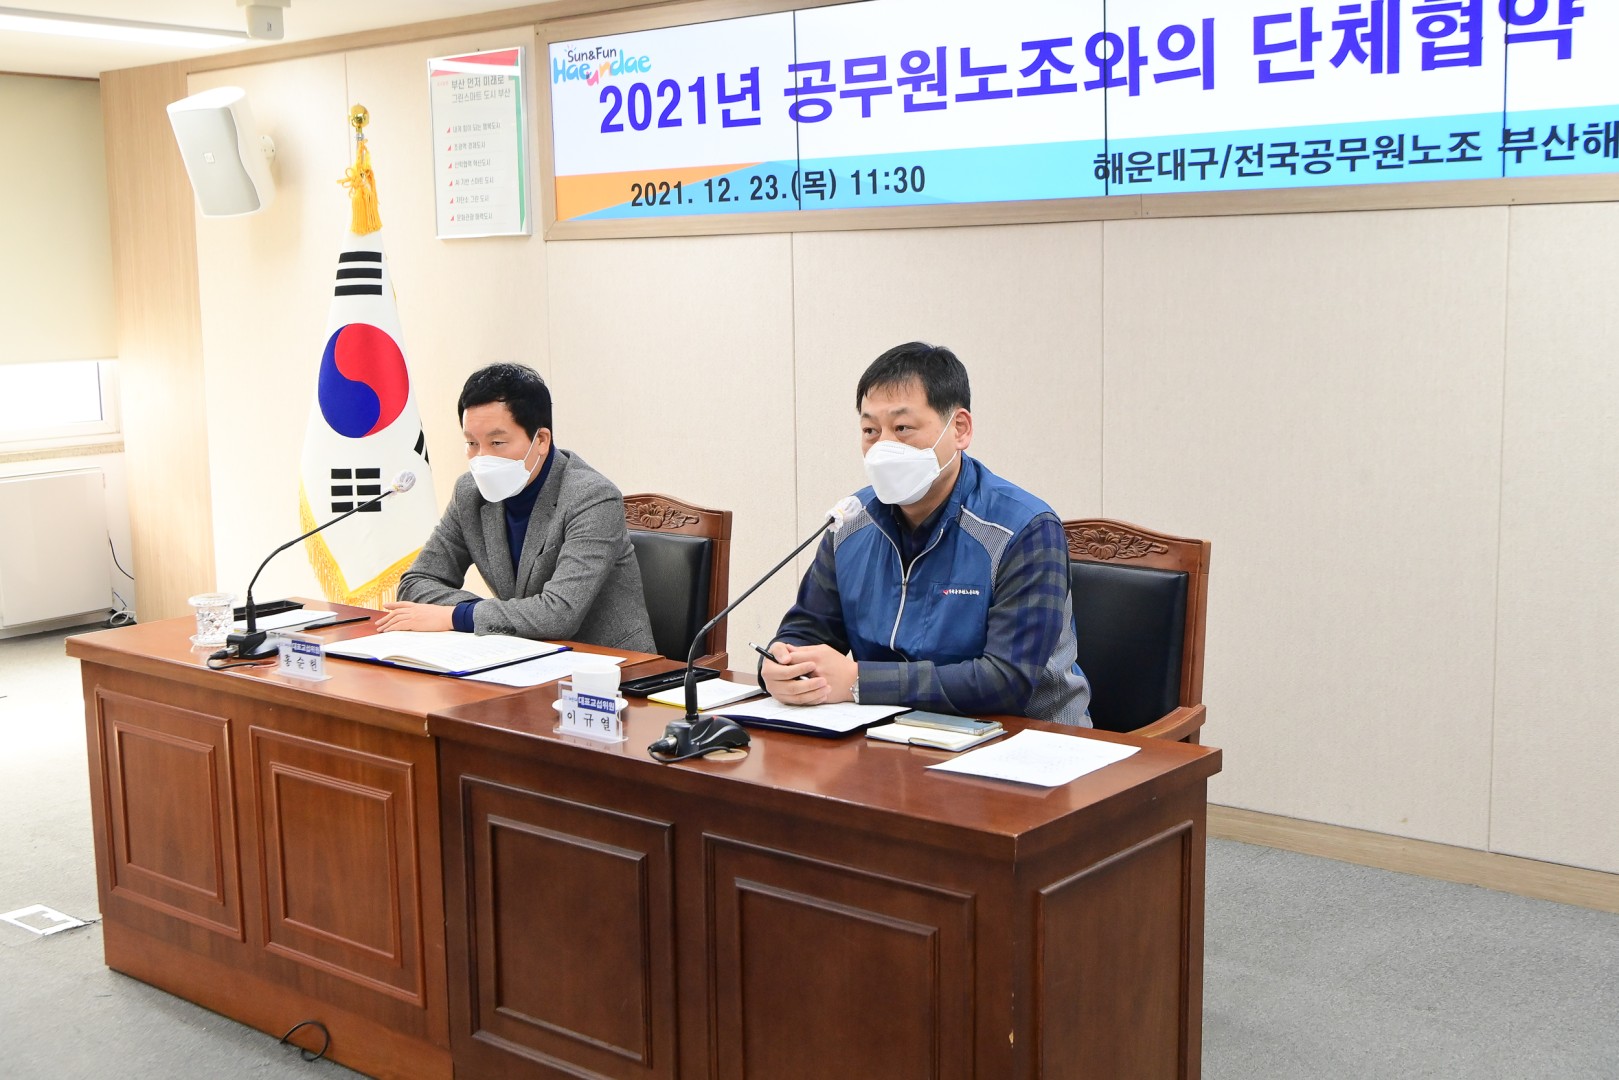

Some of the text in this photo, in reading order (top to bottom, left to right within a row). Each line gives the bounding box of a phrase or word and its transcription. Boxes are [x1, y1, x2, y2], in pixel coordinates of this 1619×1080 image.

[567, 47, 617, 63] Sun&Fun
[600, 0, 1585, 134] 2021년 공무원노조와의 단체협약
[1093, 120, 1619, 185] 해운대구/전국공무원노조 부산해
[631, 166, 926, 207] 2021. 12. 23.(목) 11:30
[578, 696, 615, 712] 대표교섭위원
